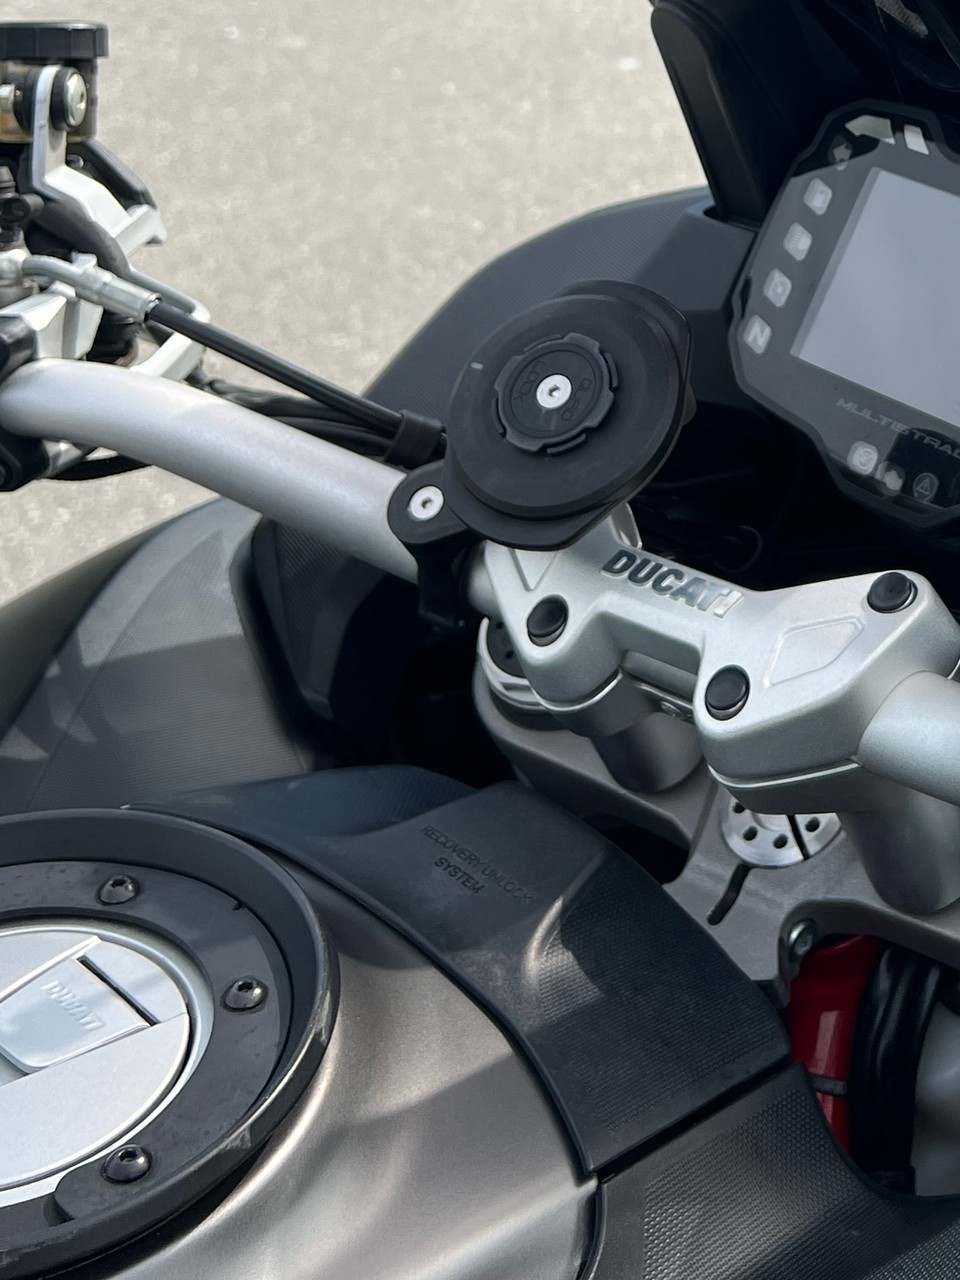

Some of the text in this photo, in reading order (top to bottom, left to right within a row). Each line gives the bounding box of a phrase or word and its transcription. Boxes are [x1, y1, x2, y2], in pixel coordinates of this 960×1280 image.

[748, 321, 771, 349] N
[513, 359, 547, 404] LOCK
[601, 549, 745, 619] DUCATI
[420, 824, 534, 902] RECOVERY UNLOCK
[434, 856, 486, 894] SYSTEM
[40, 979, 106, 1033] DUCATI
